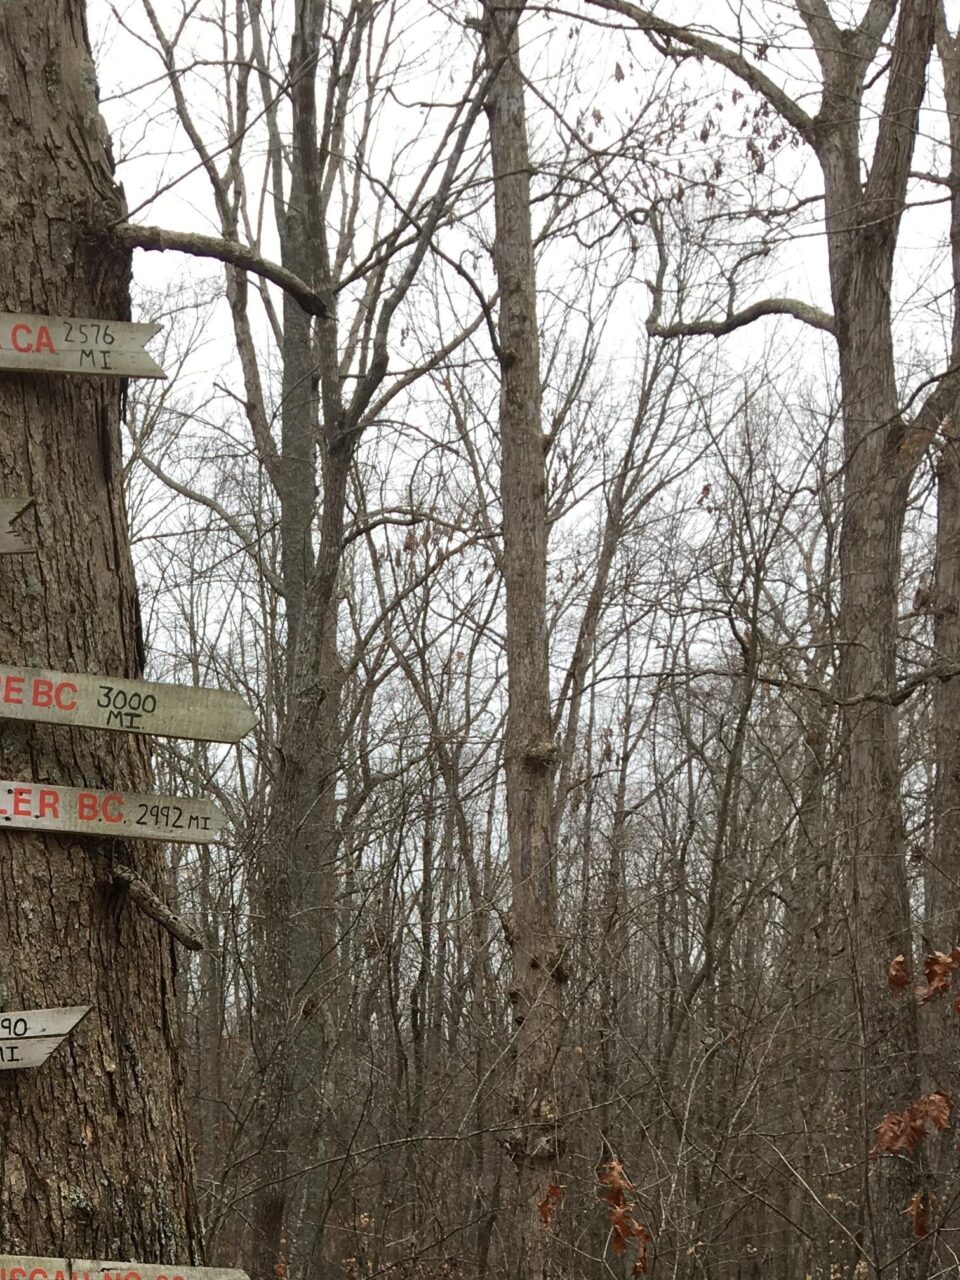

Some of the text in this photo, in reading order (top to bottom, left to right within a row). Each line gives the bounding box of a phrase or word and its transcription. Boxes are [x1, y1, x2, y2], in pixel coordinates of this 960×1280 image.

[63, 321, 115, 345] 2576
[97, 685, 157, 714] 3000
[136, 803, 184, 829] 2992
[188, 815, 213, 831] MI
